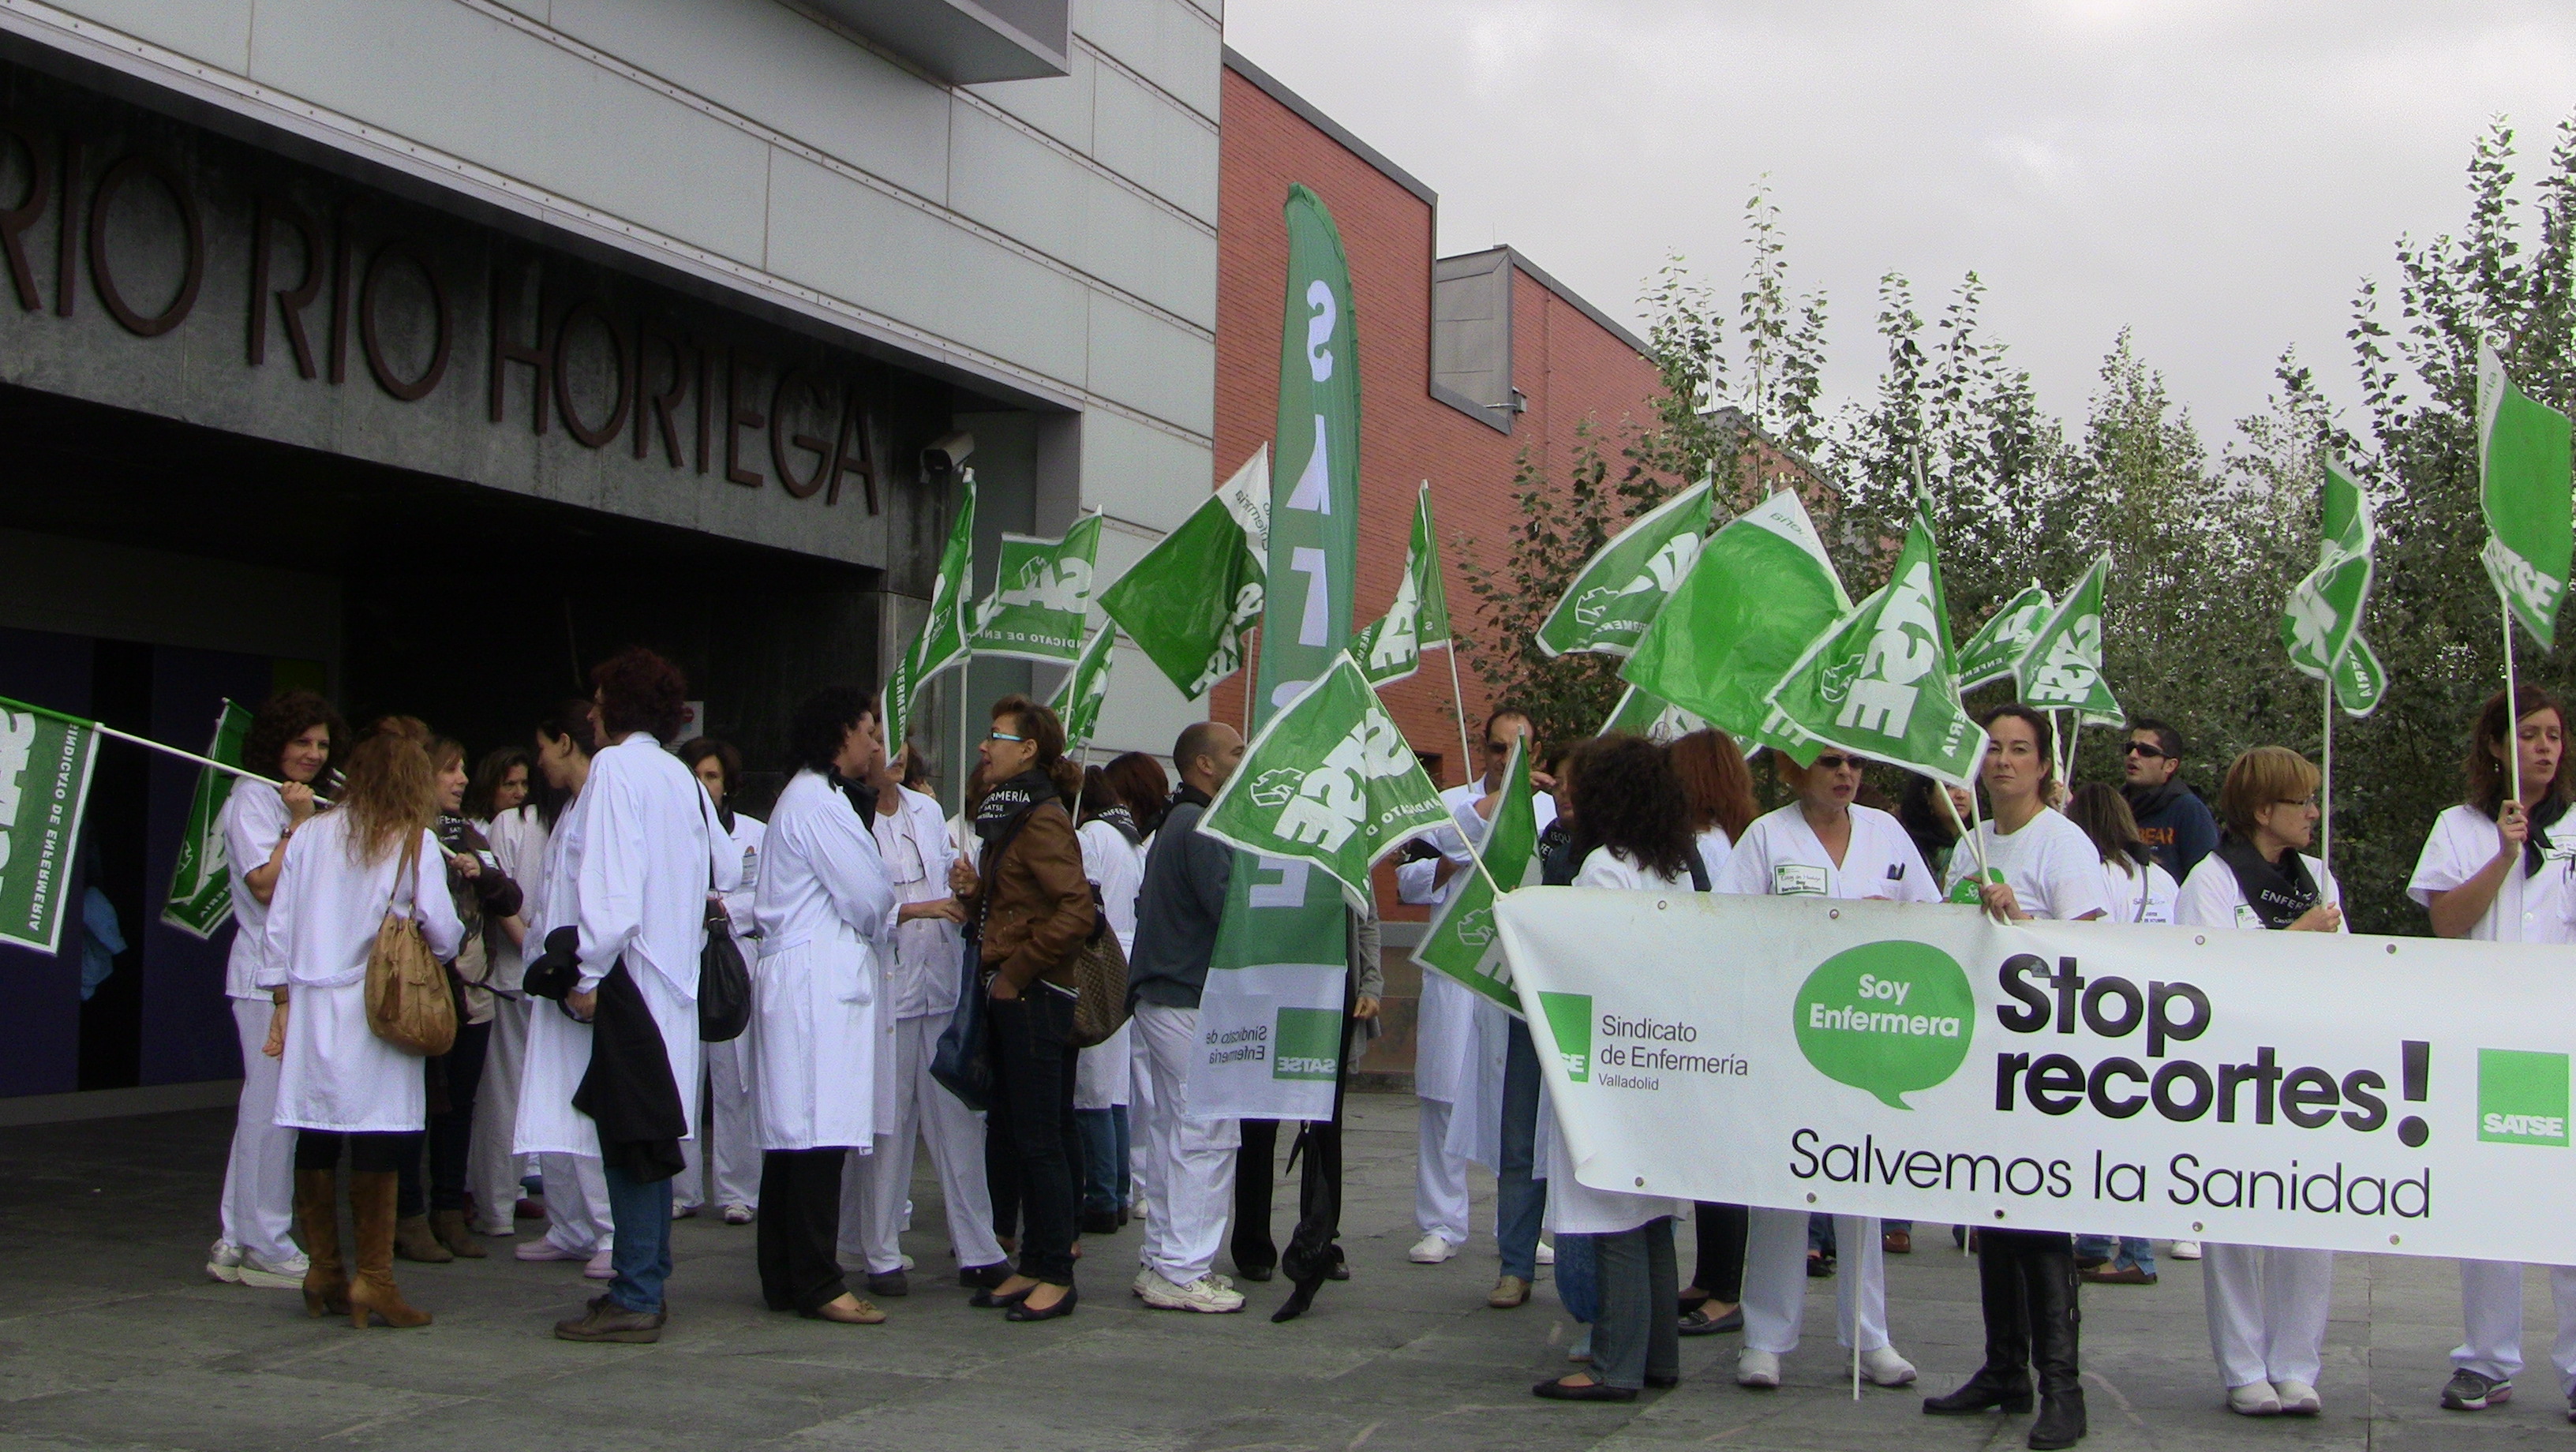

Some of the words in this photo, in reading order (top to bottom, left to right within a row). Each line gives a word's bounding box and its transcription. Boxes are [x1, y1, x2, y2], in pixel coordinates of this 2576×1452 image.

[490, 266, 880, 516] HORTEGA
[1858, 973, 1911, 1005] Soy
[1997, 952, 2211, 1057] Stop
[1601, 1014, 1697, 1042] Sindicato
[1809, 1002, 1960, 1038] Enfermera
[1601, 1043, 1626, 1065] de
[1631, 1046, 1748, 1076] Enfermería
[1598, 1072, 1660, 1091] Valladolid
[1995, 1039, 2430, 1148] recortes!
[2483, 1113, 2565, 1137] SATSE
[1789, 1128, 2072, 1198] Salvemos
[2095, 1149, 2146, 1202] la
[2168, 1153, 2430, 1218] Sanidad
